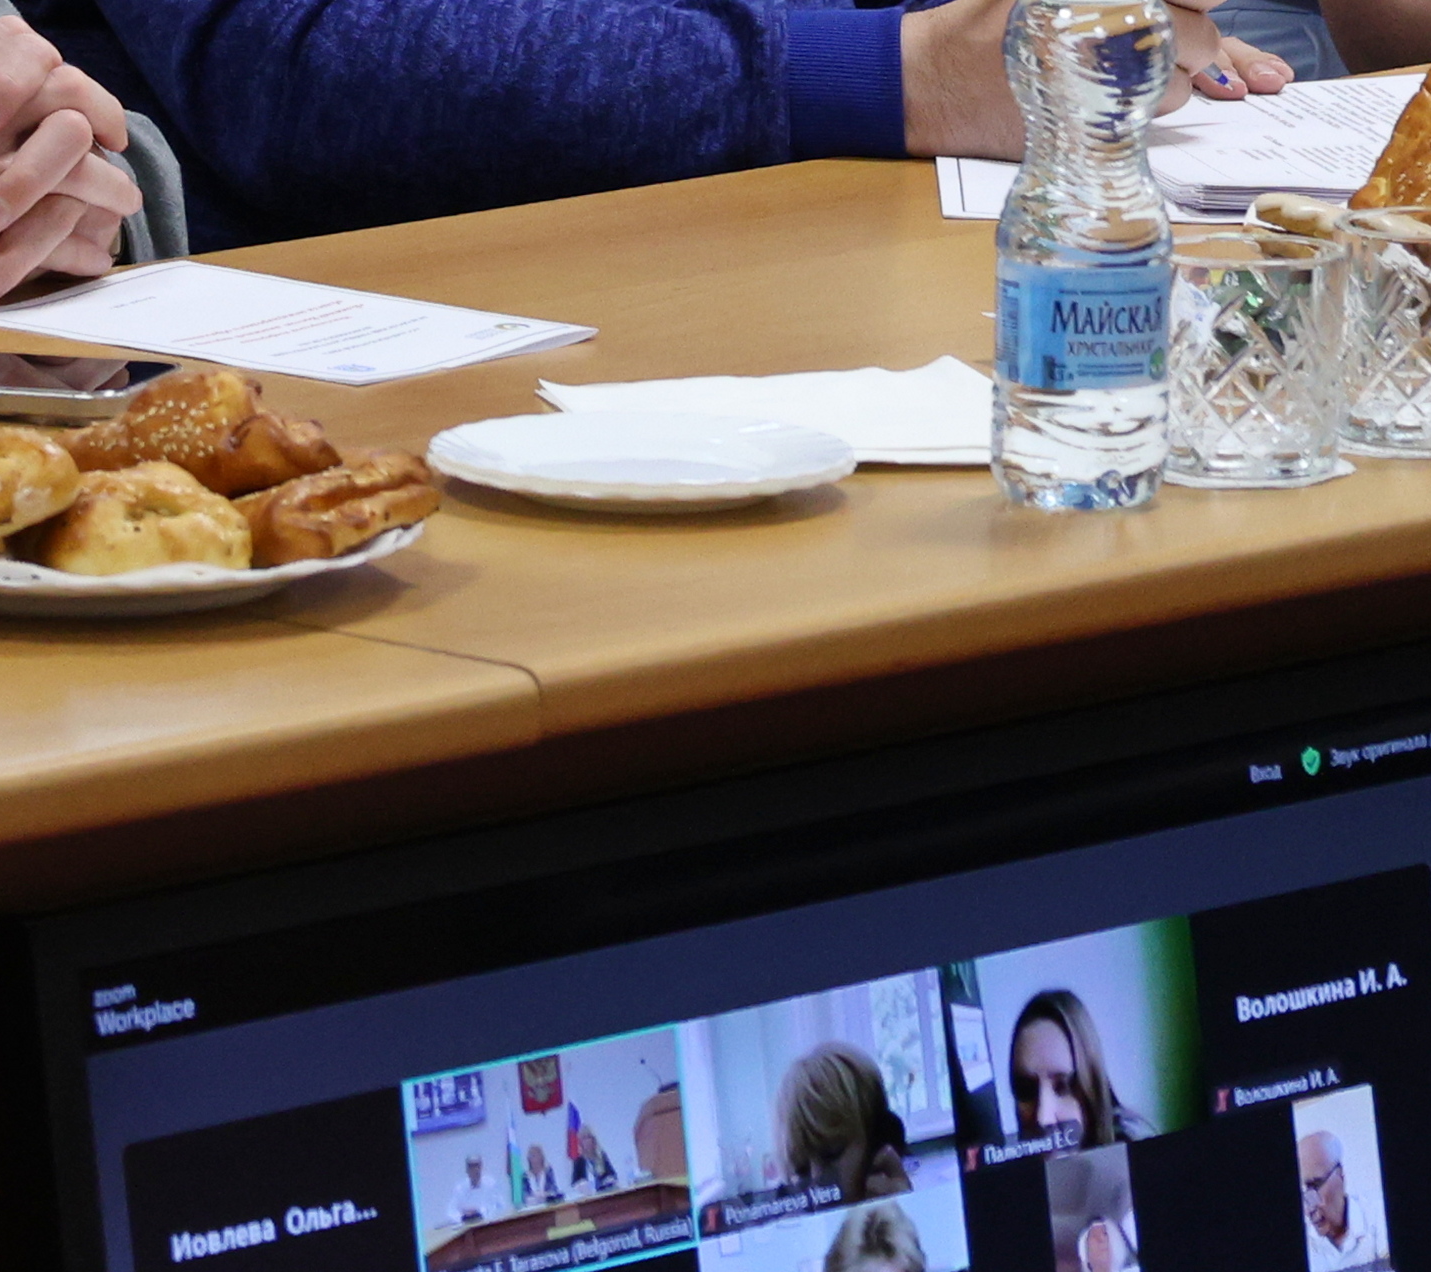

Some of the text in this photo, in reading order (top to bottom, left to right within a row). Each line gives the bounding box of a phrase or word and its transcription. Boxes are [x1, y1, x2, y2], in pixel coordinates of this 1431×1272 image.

[94, 984, 137, 1007] zoom
[1235, 962, 1408, 1023] Волошкина И. А.
[95, 997, 196, 1036] Workplace
[1233, 1076, 1308, 1108] Волошкина
[809, 1184, 842, 1205] Vera
[170, 1217, 277, 1263] Иовлева
